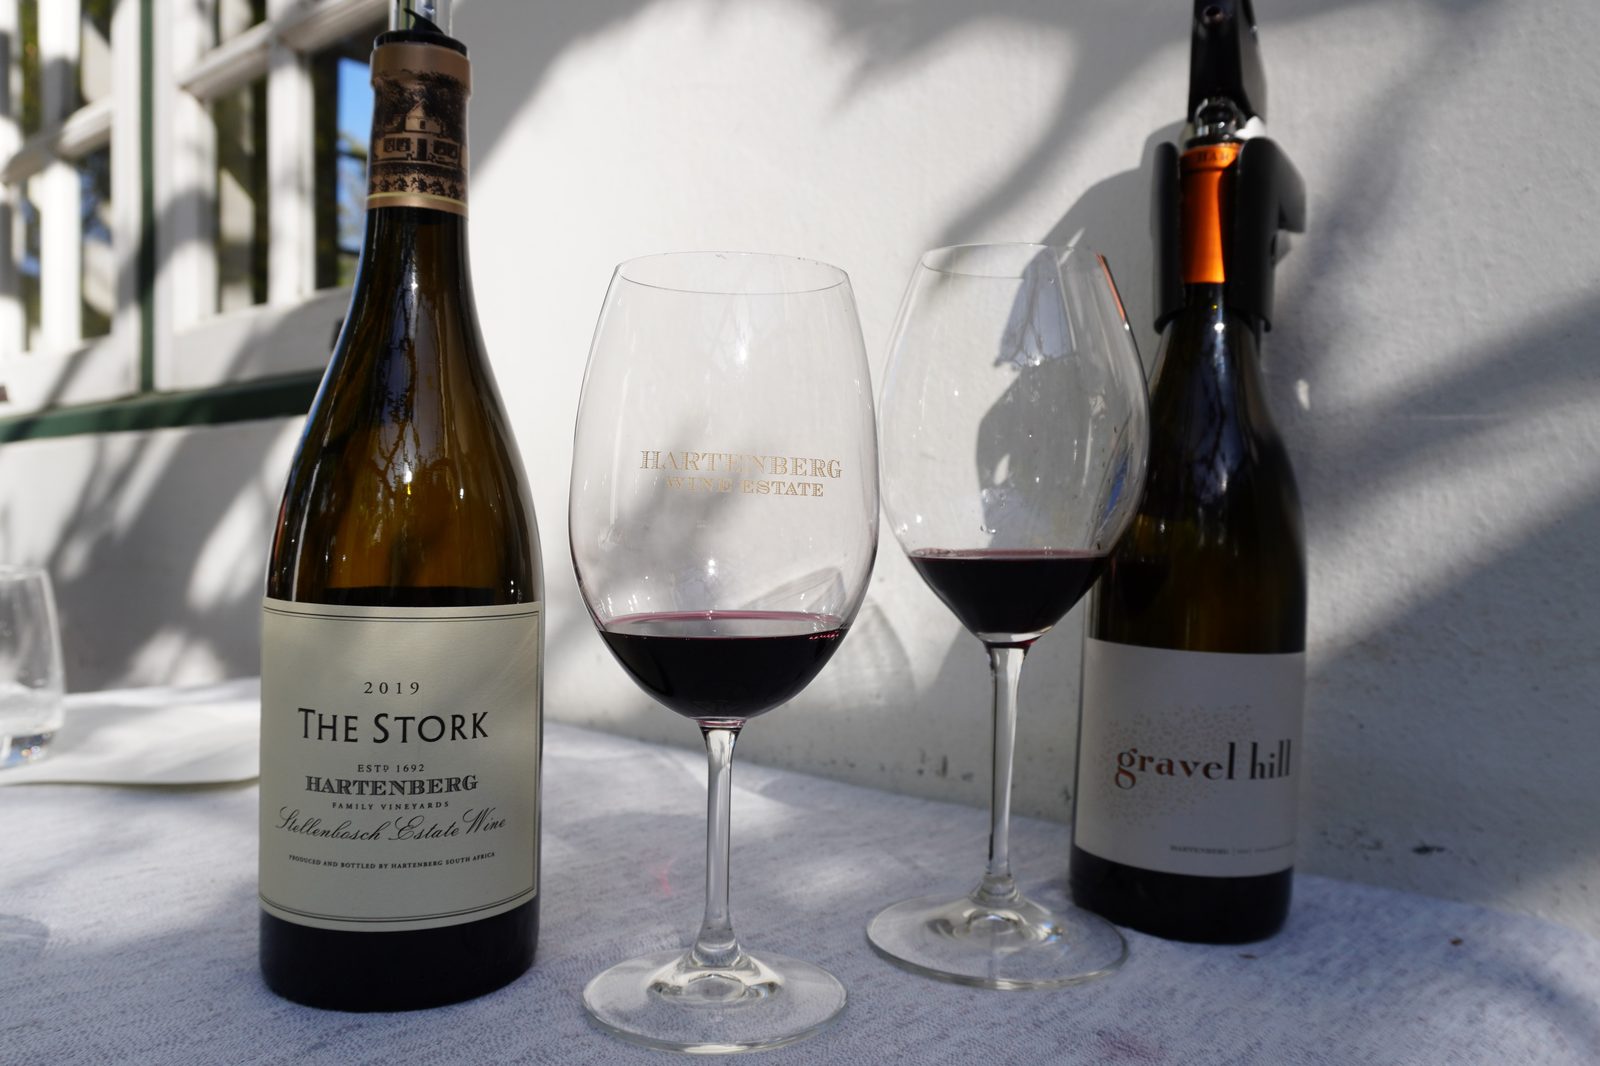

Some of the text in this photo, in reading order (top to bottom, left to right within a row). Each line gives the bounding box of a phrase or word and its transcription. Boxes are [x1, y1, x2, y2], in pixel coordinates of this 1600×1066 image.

[640, 450, 843, 479] HARTENBERG
[663, 475, 824, 497] WINE ESTATE
[363, 681, 420, 695] 2019
[396, 763, 425, 773] 1692
[1114, 739, 1292, 790] gravel hill
[305, 775, 479, 796] HARTENBERG
[332, 801, 450, 811] FAMILY VINEYARDS
[275, 806, 507, 841] Stellenbosch Estate Wine
[288, 854, 321, 866] PRODUCED
[322, 860, 338, 868] AND
[340, 862, 376, 870] BOTTLED
[391, 860, 443, 869] HARTENBERG
[445, 855, 471, 865] SOUTH
[472, 851, 496, 862] AFRICA
